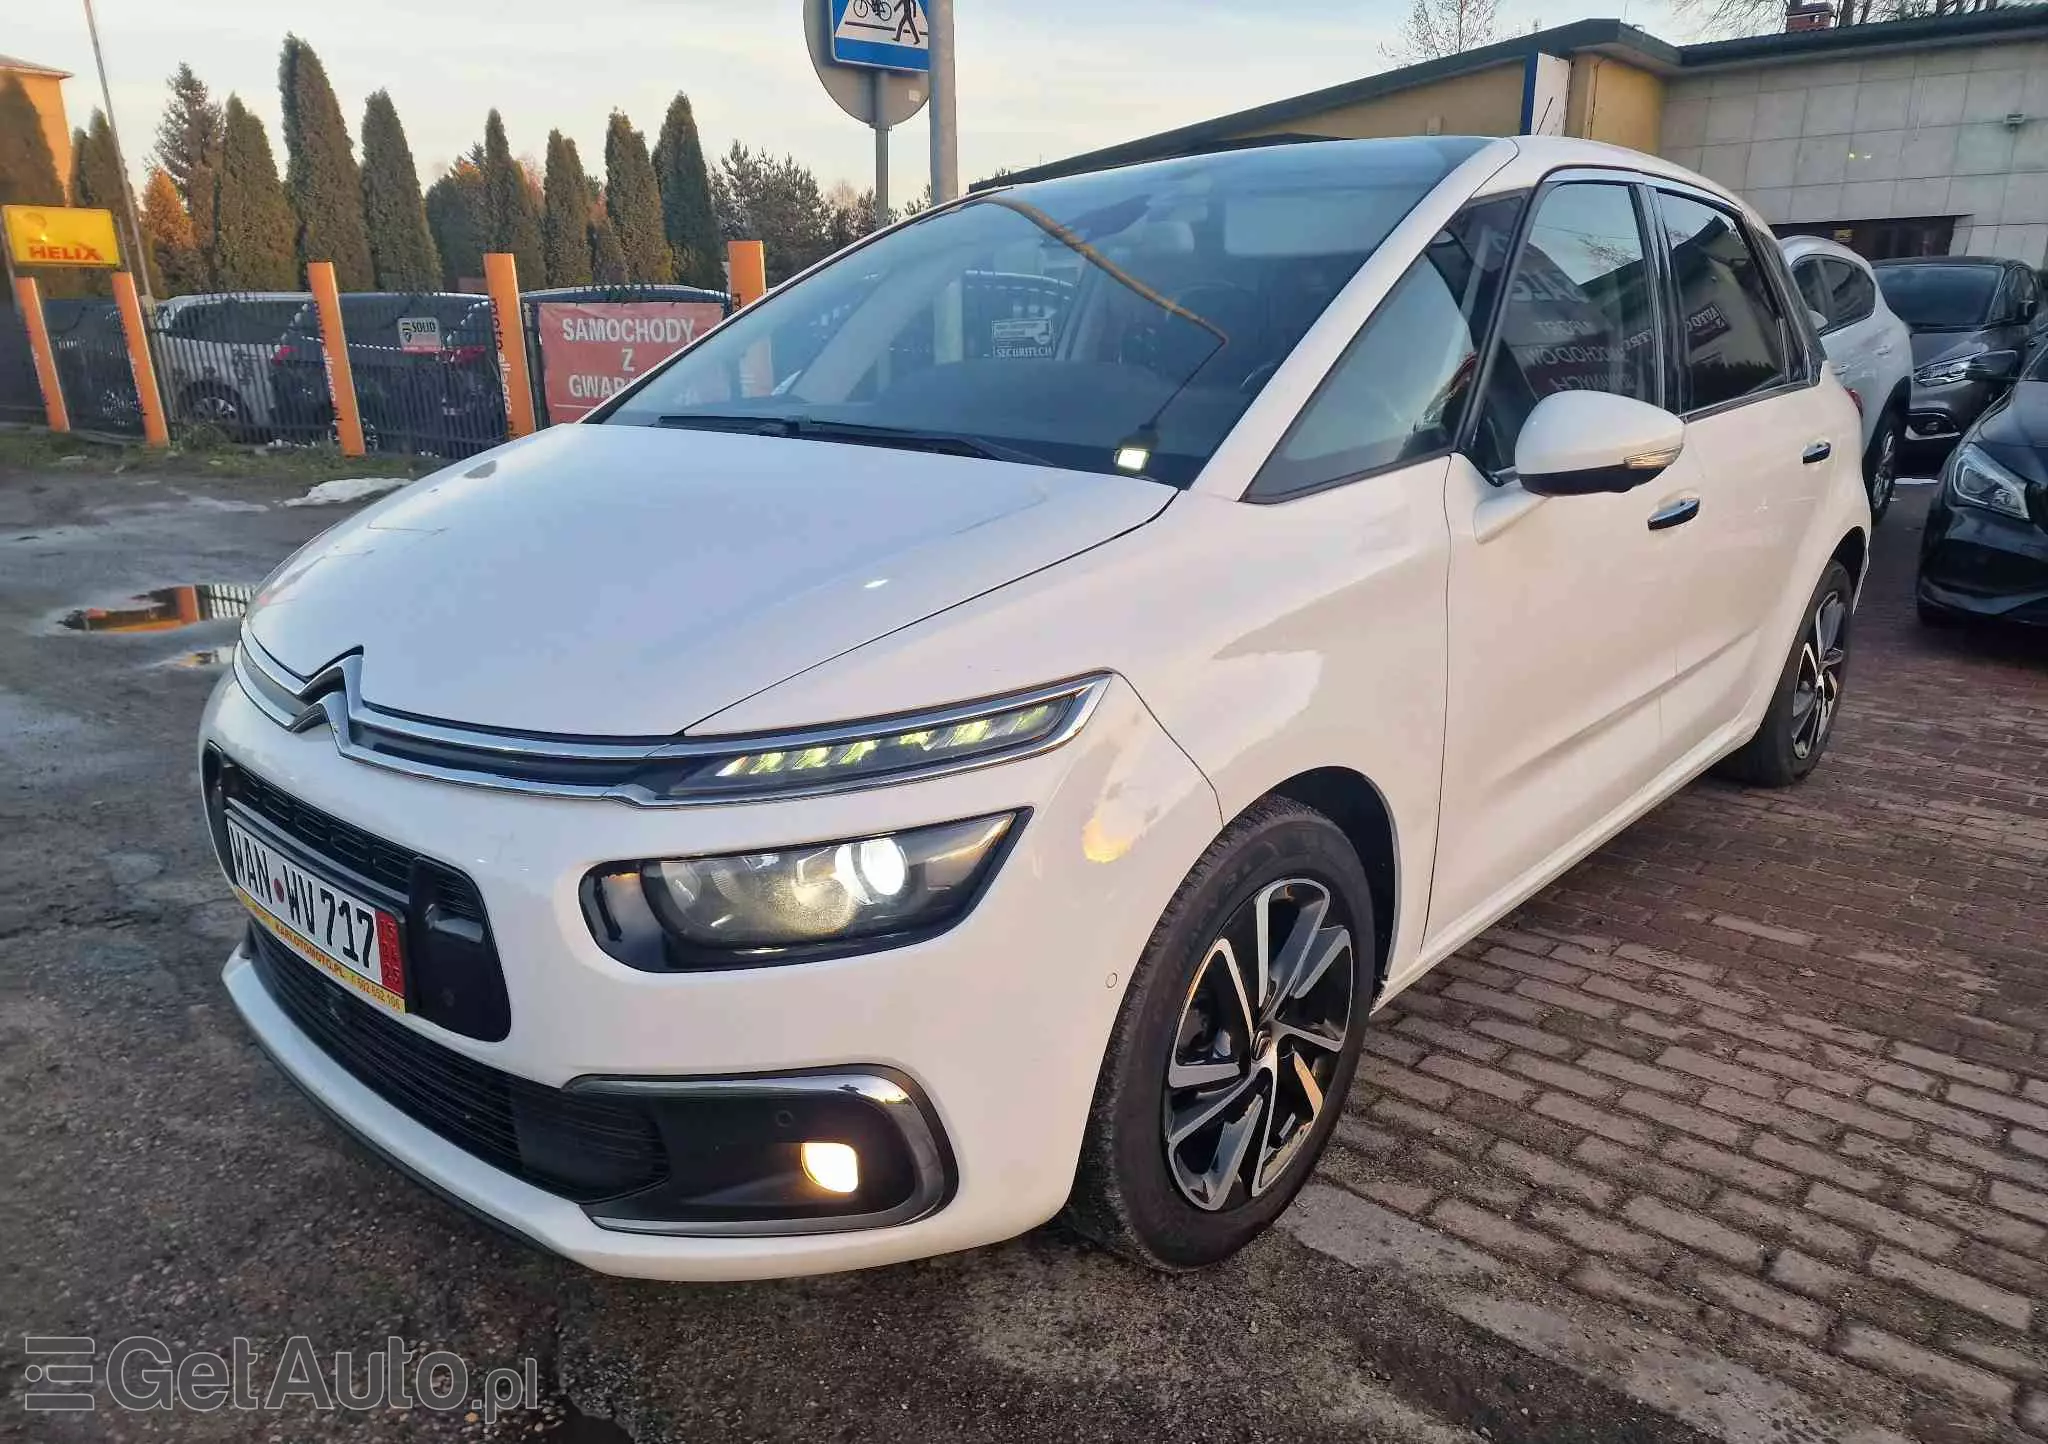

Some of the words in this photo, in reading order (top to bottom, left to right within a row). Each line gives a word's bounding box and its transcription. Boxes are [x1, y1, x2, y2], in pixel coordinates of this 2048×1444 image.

[28, 245, 104, 261] HELIX
[562, 317, 695, 343] SAMOCHODY
[622, 348, 635, 372] Z
[229, 823, 273, 905] WAN
[319, 887, 375, 969] 717
